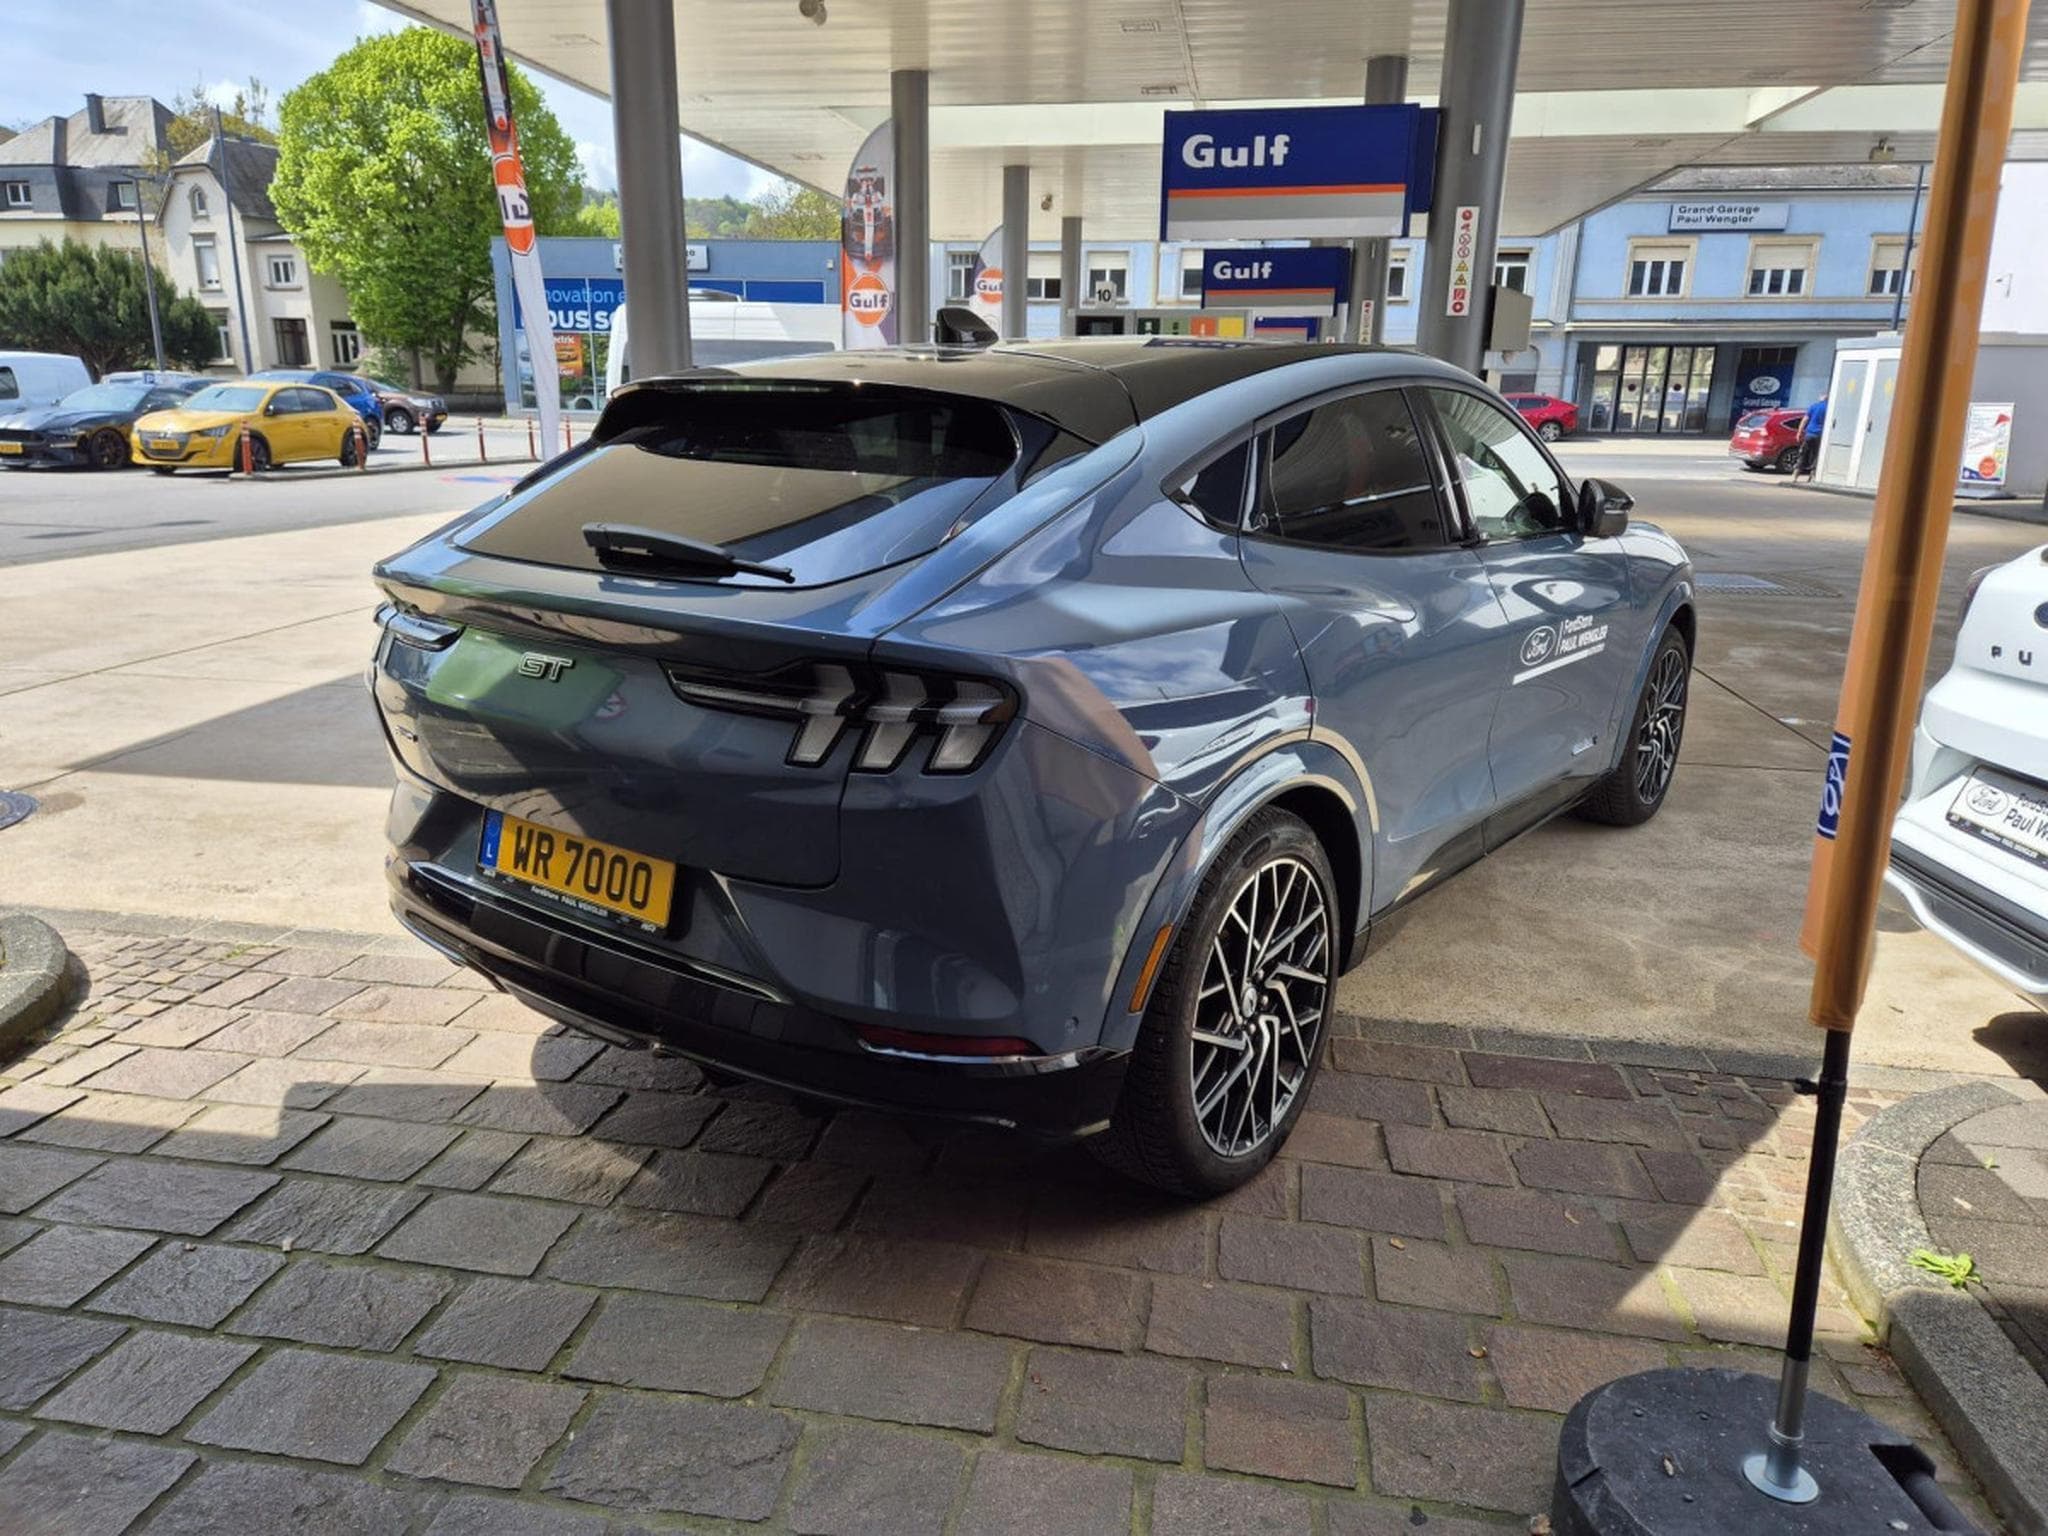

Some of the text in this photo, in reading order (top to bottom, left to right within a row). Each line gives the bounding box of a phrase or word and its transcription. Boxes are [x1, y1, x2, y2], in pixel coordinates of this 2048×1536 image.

[1181, 133, 1291, 169] Gulf
[1678, 204, 1760, 214] Grand Garage
[1677, 214, 1754, 224] Paul Wengler
[1212, 260, 1272, 280] Gulf
[976, 280, 1003, 292] Gul
[850, 292, 888, 308] Gulf
[1098, 289, 1112, 302] 10
[518, 651, 574, 682] GT
[2002, 808, 2037, 834] Paul
[513, 824, 653, 911] WR 7000
